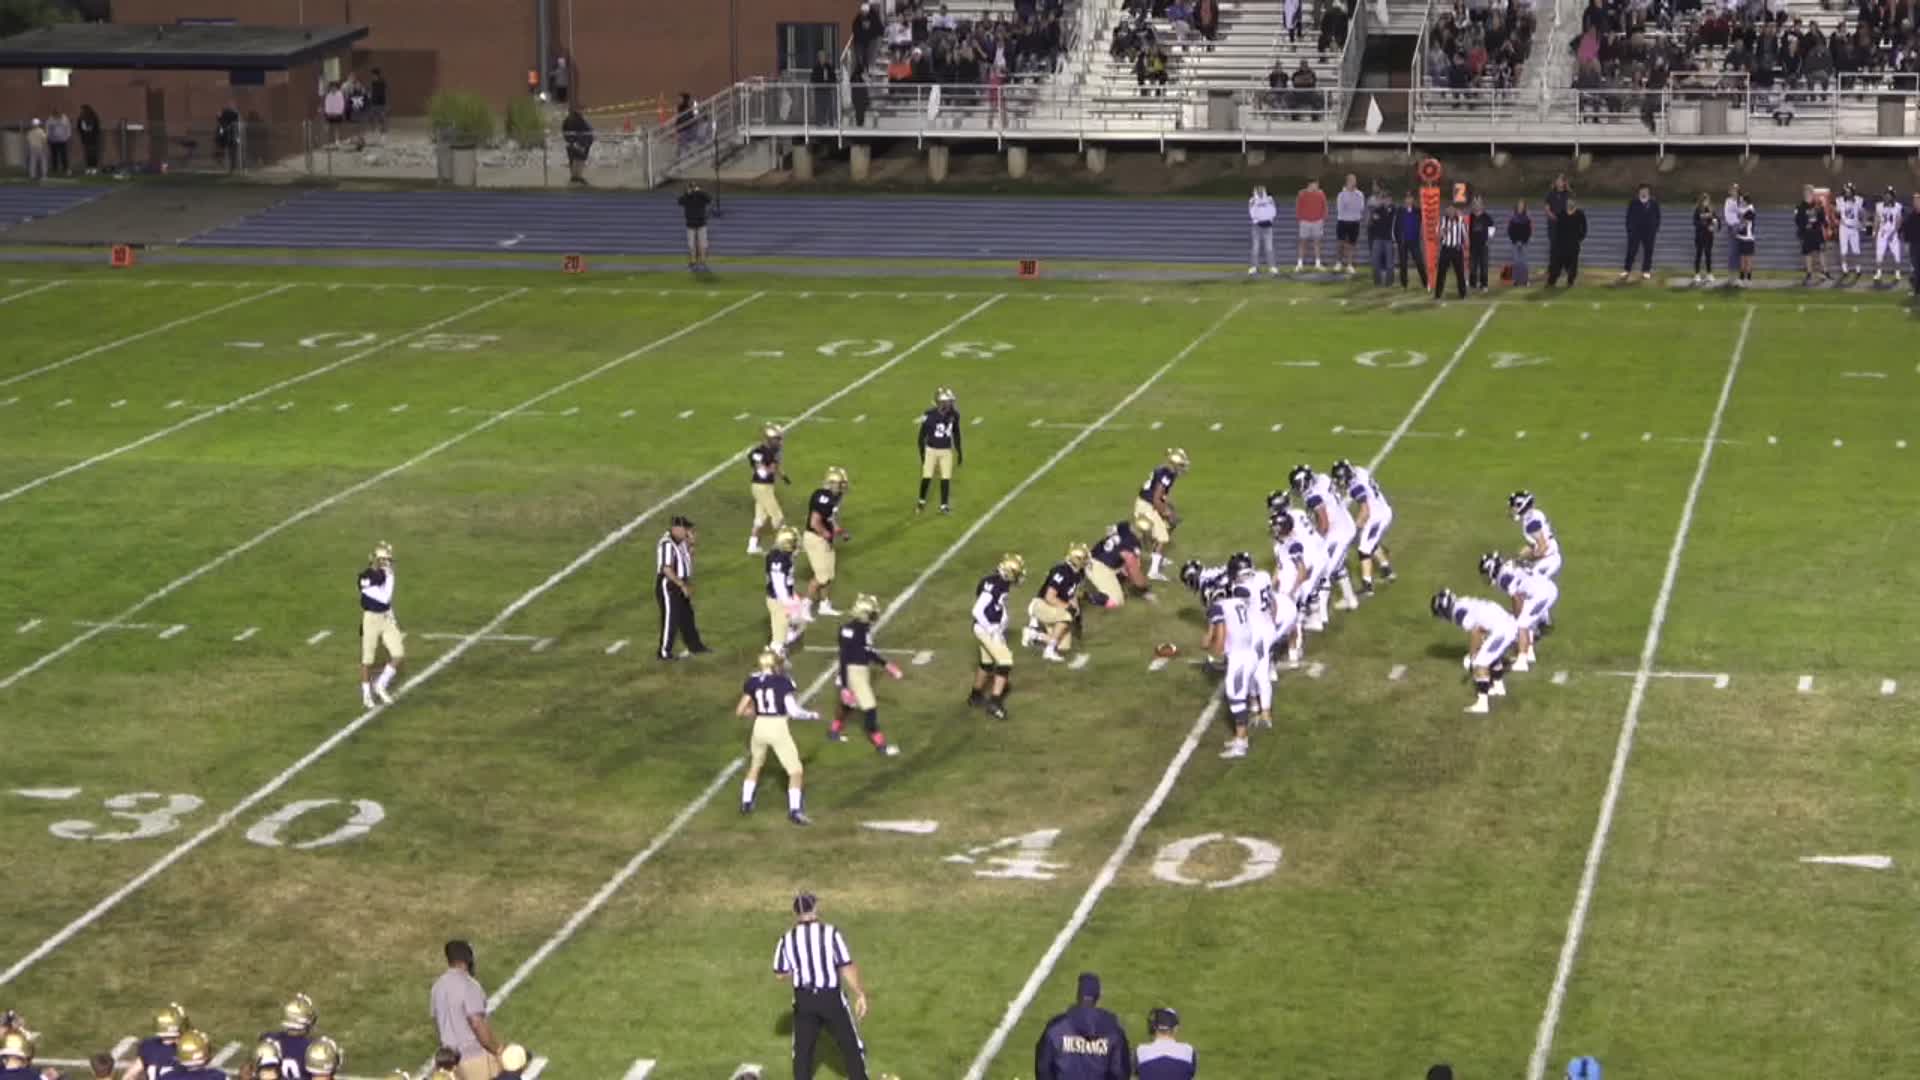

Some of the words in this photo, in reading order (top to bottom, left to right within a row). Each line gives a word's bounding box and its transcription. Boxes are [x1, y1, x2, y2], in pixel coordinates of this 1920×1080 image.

[755, 687, 778, 714] 11
[49, 791, 386, 849] 30
[938, 828, 1282, 889] 40
[1062, 1034, 1110, 1056] MUSTANGS
